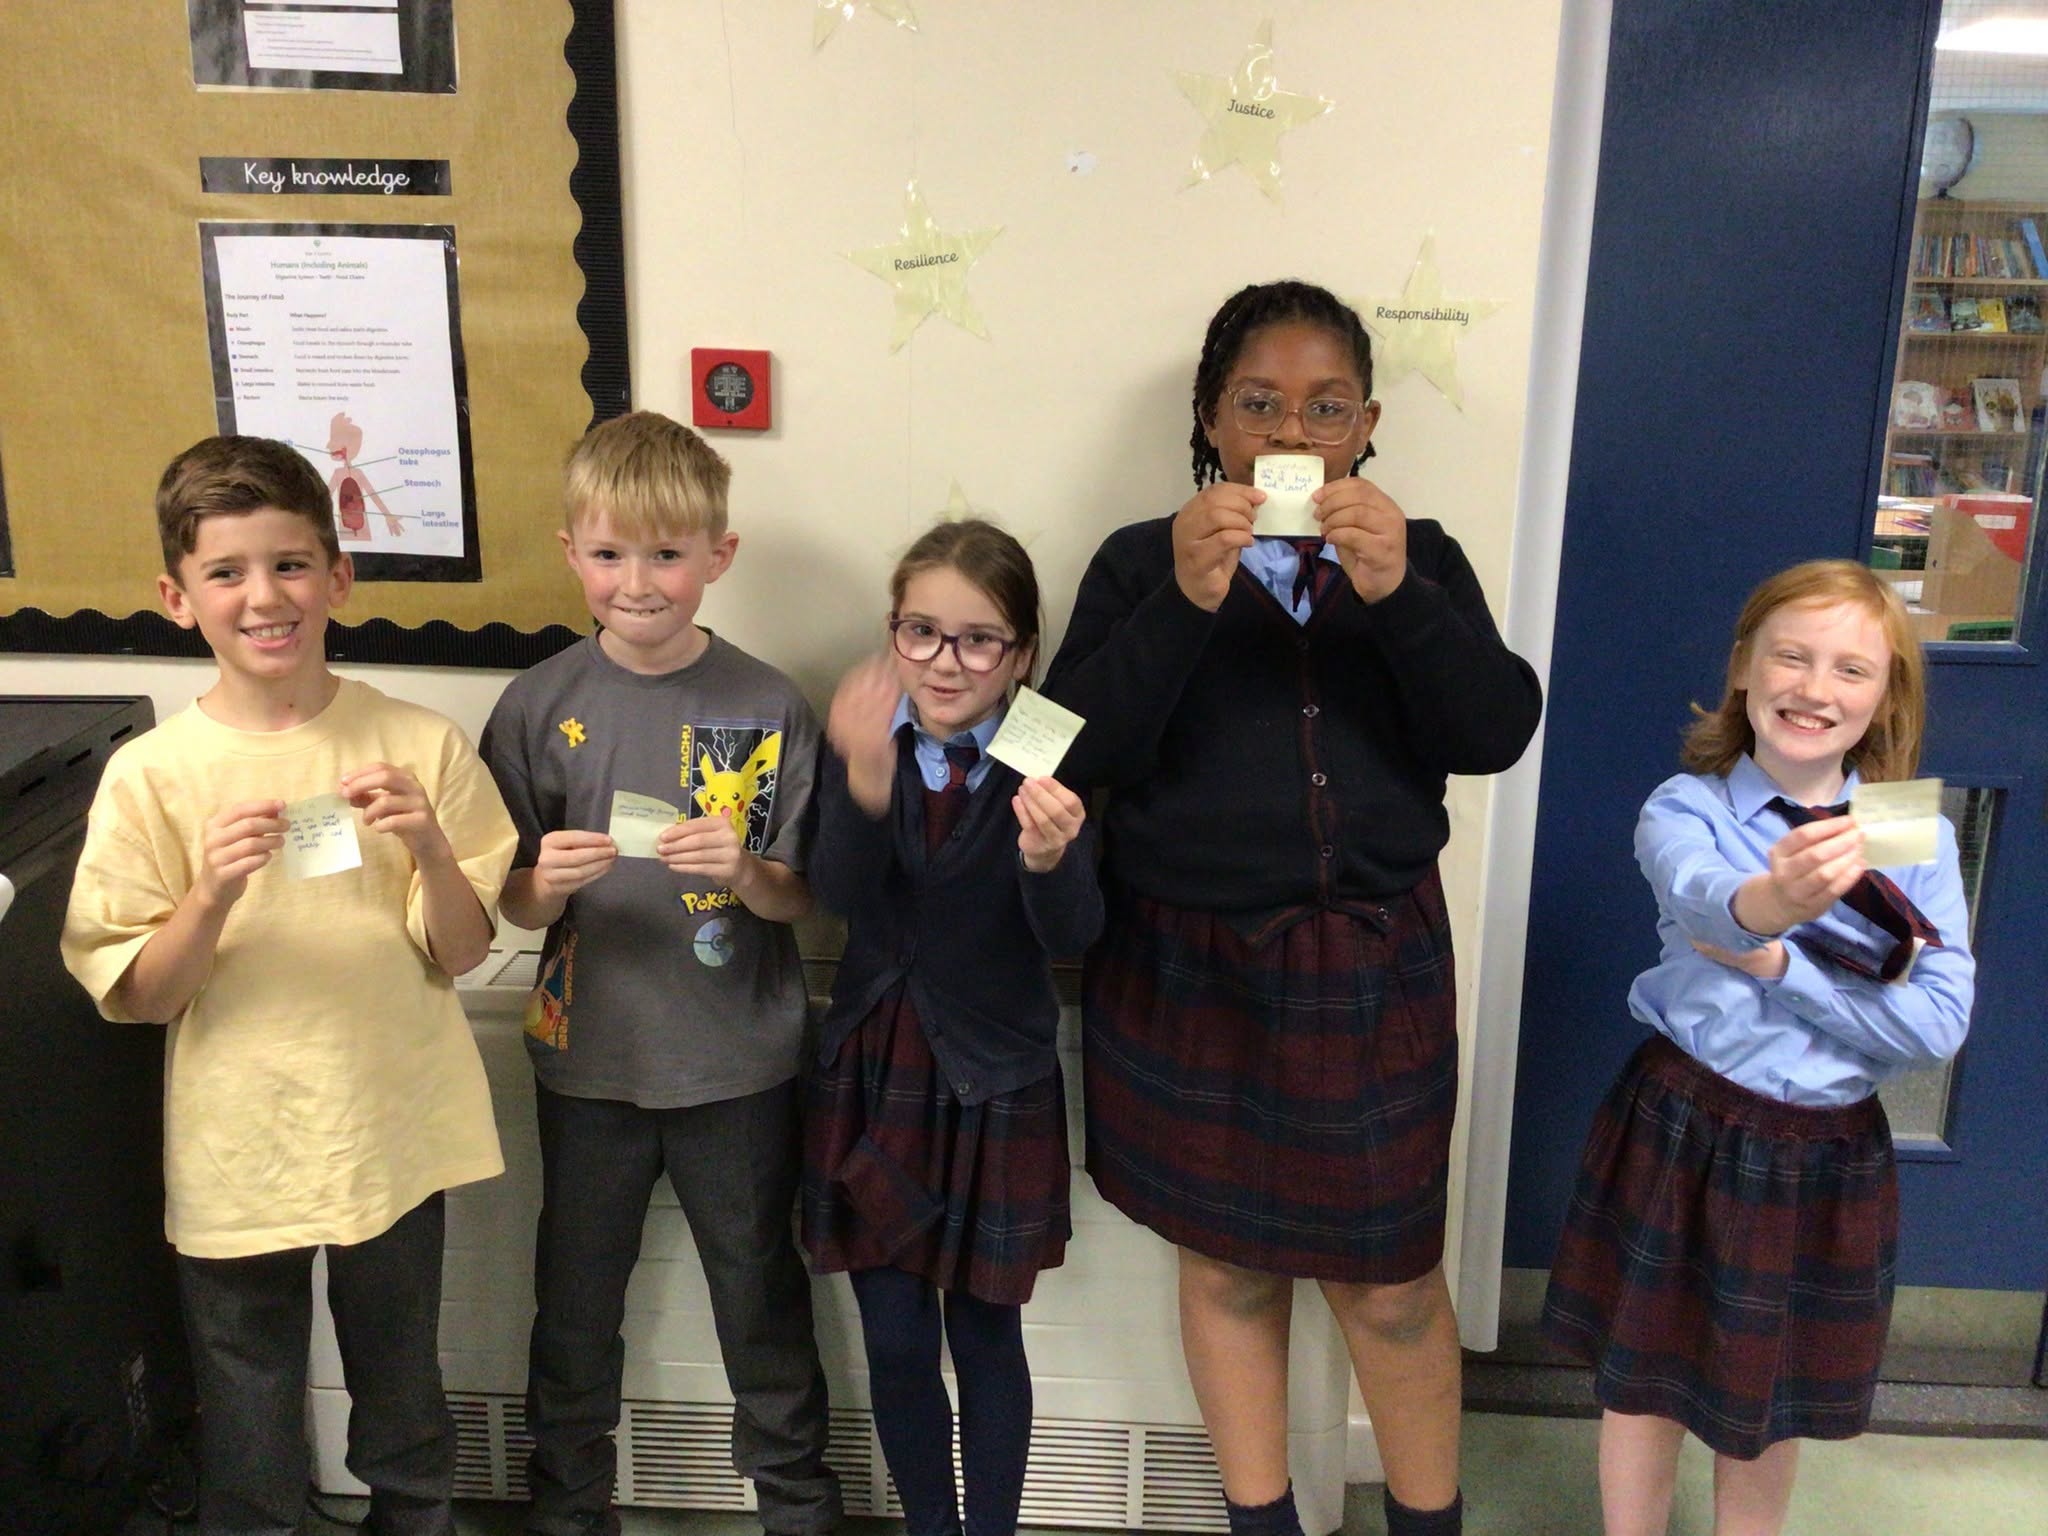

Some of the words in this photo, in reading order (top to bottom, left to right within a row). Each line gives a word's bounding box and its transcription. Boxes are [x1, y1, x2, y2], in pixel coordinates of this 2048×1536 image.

[1227, 98, 1276, 120] Justice
[244, 162, 285, 193] Key
[291, 162, 410, 195] knowledge
[894, 252, 960, 271] Resilience
[1376, 306, 1469, 326] Responsibility
[398, 447, 451, 456] Oesophagus
[399, 458, 419, 466] tube
[404, 479, 442, 488] Stomach
[421, 509, 446, 518] Large
[680, 724, 692, 788] PIKACHU
